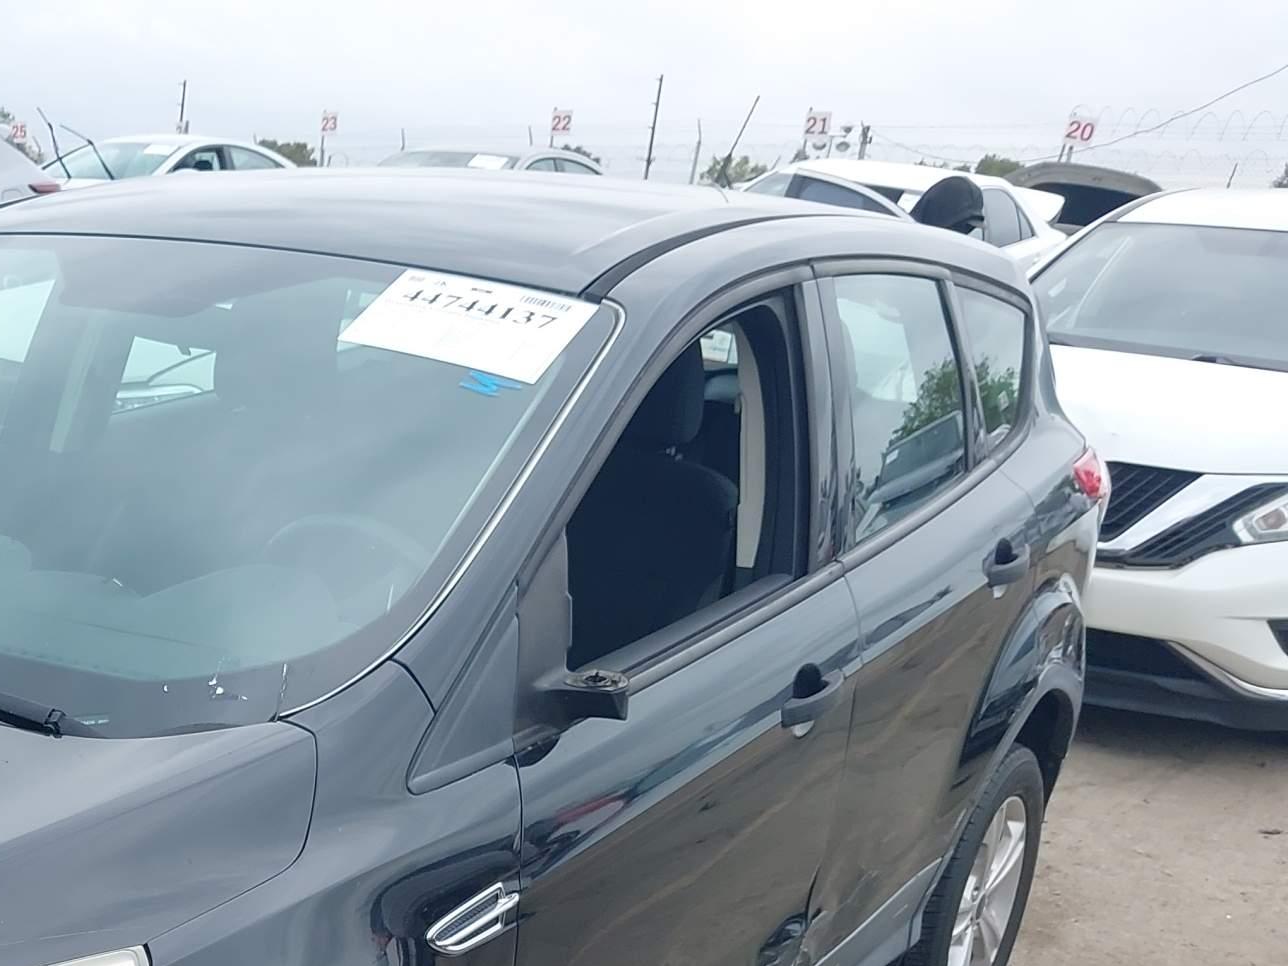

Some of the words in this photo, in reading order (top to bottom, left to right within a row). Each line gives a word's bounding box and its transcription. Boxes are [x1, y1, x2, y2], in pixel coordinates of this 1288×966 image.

[12, 124, 27, 139] 25
[322, 115, 337, 131] 23
[552, 115, 572, 131] 22
[805, 116, 828, 135] 21
[1065, 120, 1095, 142] 20
[402, 289, 558, 329] 44744137
